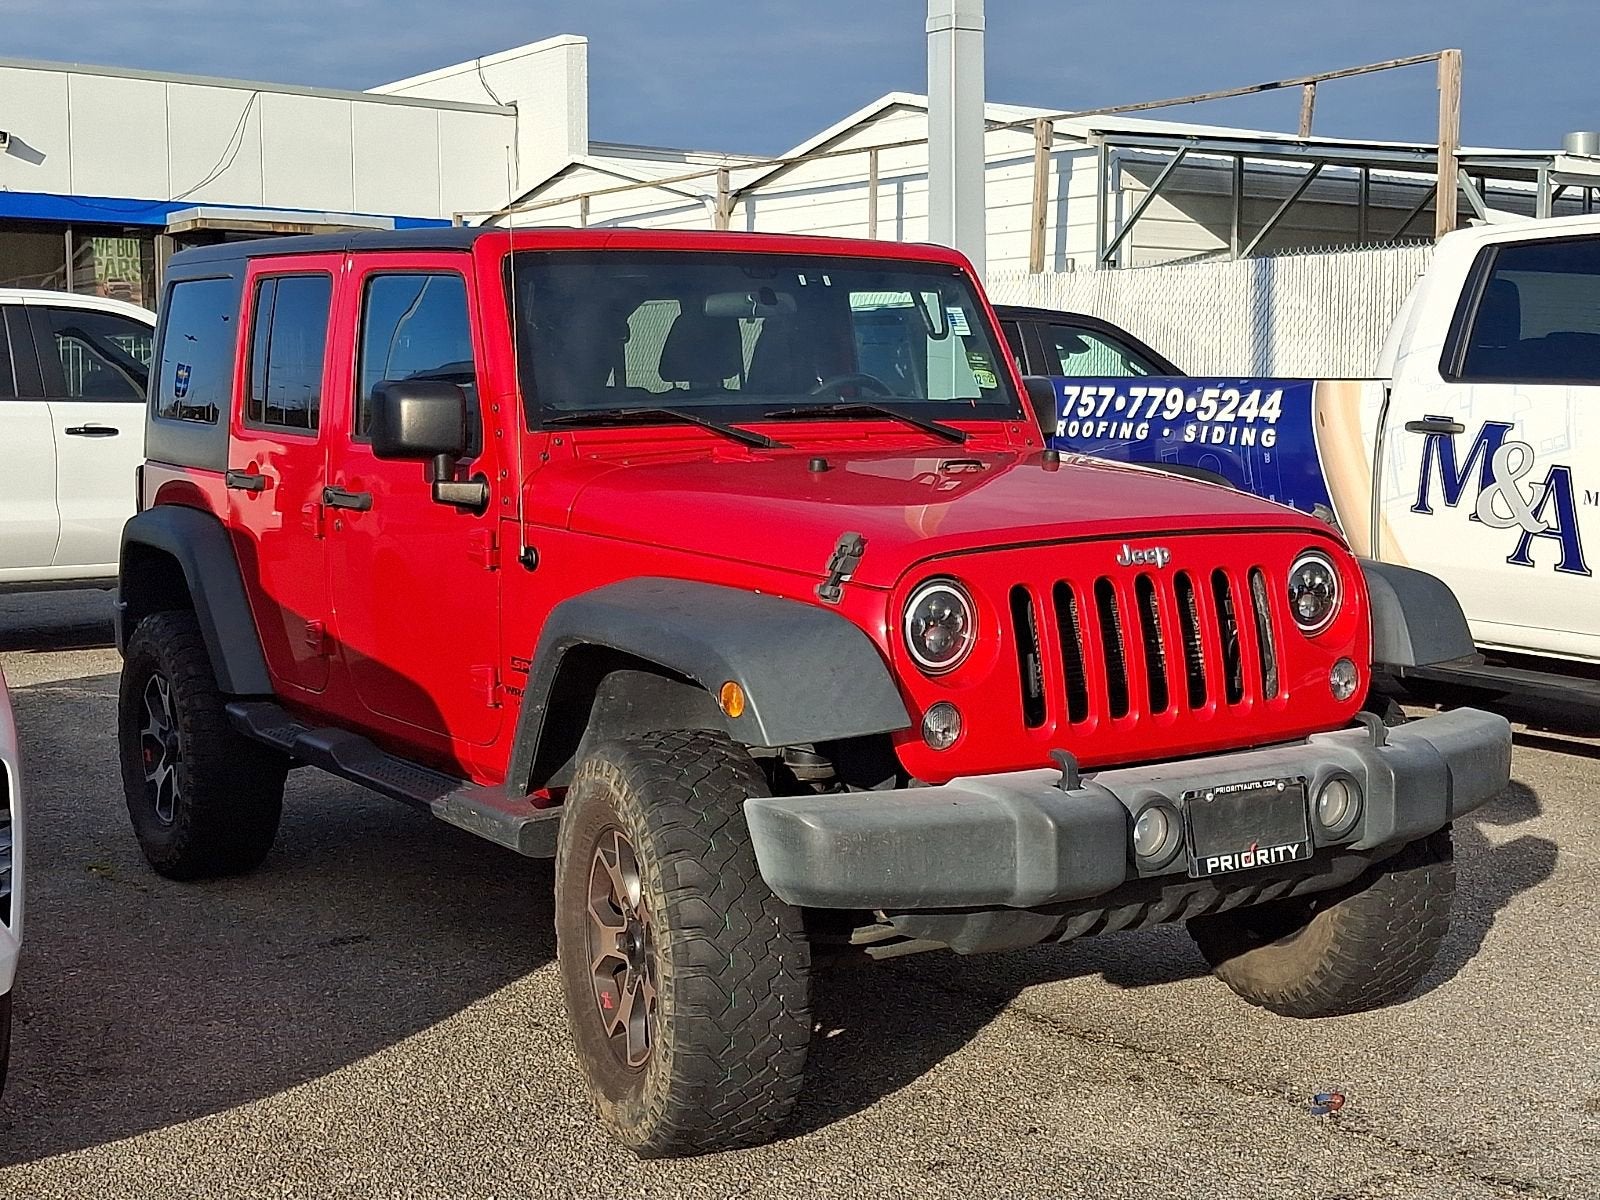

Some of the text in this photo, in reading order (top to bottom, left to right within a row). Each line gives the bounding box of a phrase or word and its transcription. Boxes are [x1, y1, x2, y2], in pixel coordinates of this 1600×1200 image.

[93, 238, 113, 257] WE
[95, 257, 140, 281] CARS
[1055, 420, 1277, 448] ROOFING SIDING
[1410, 414, 1593, 578] M&A
[1116, 543, 1170, 569] Jeep
[1206, 843, 1300, 874] PRIORITY
